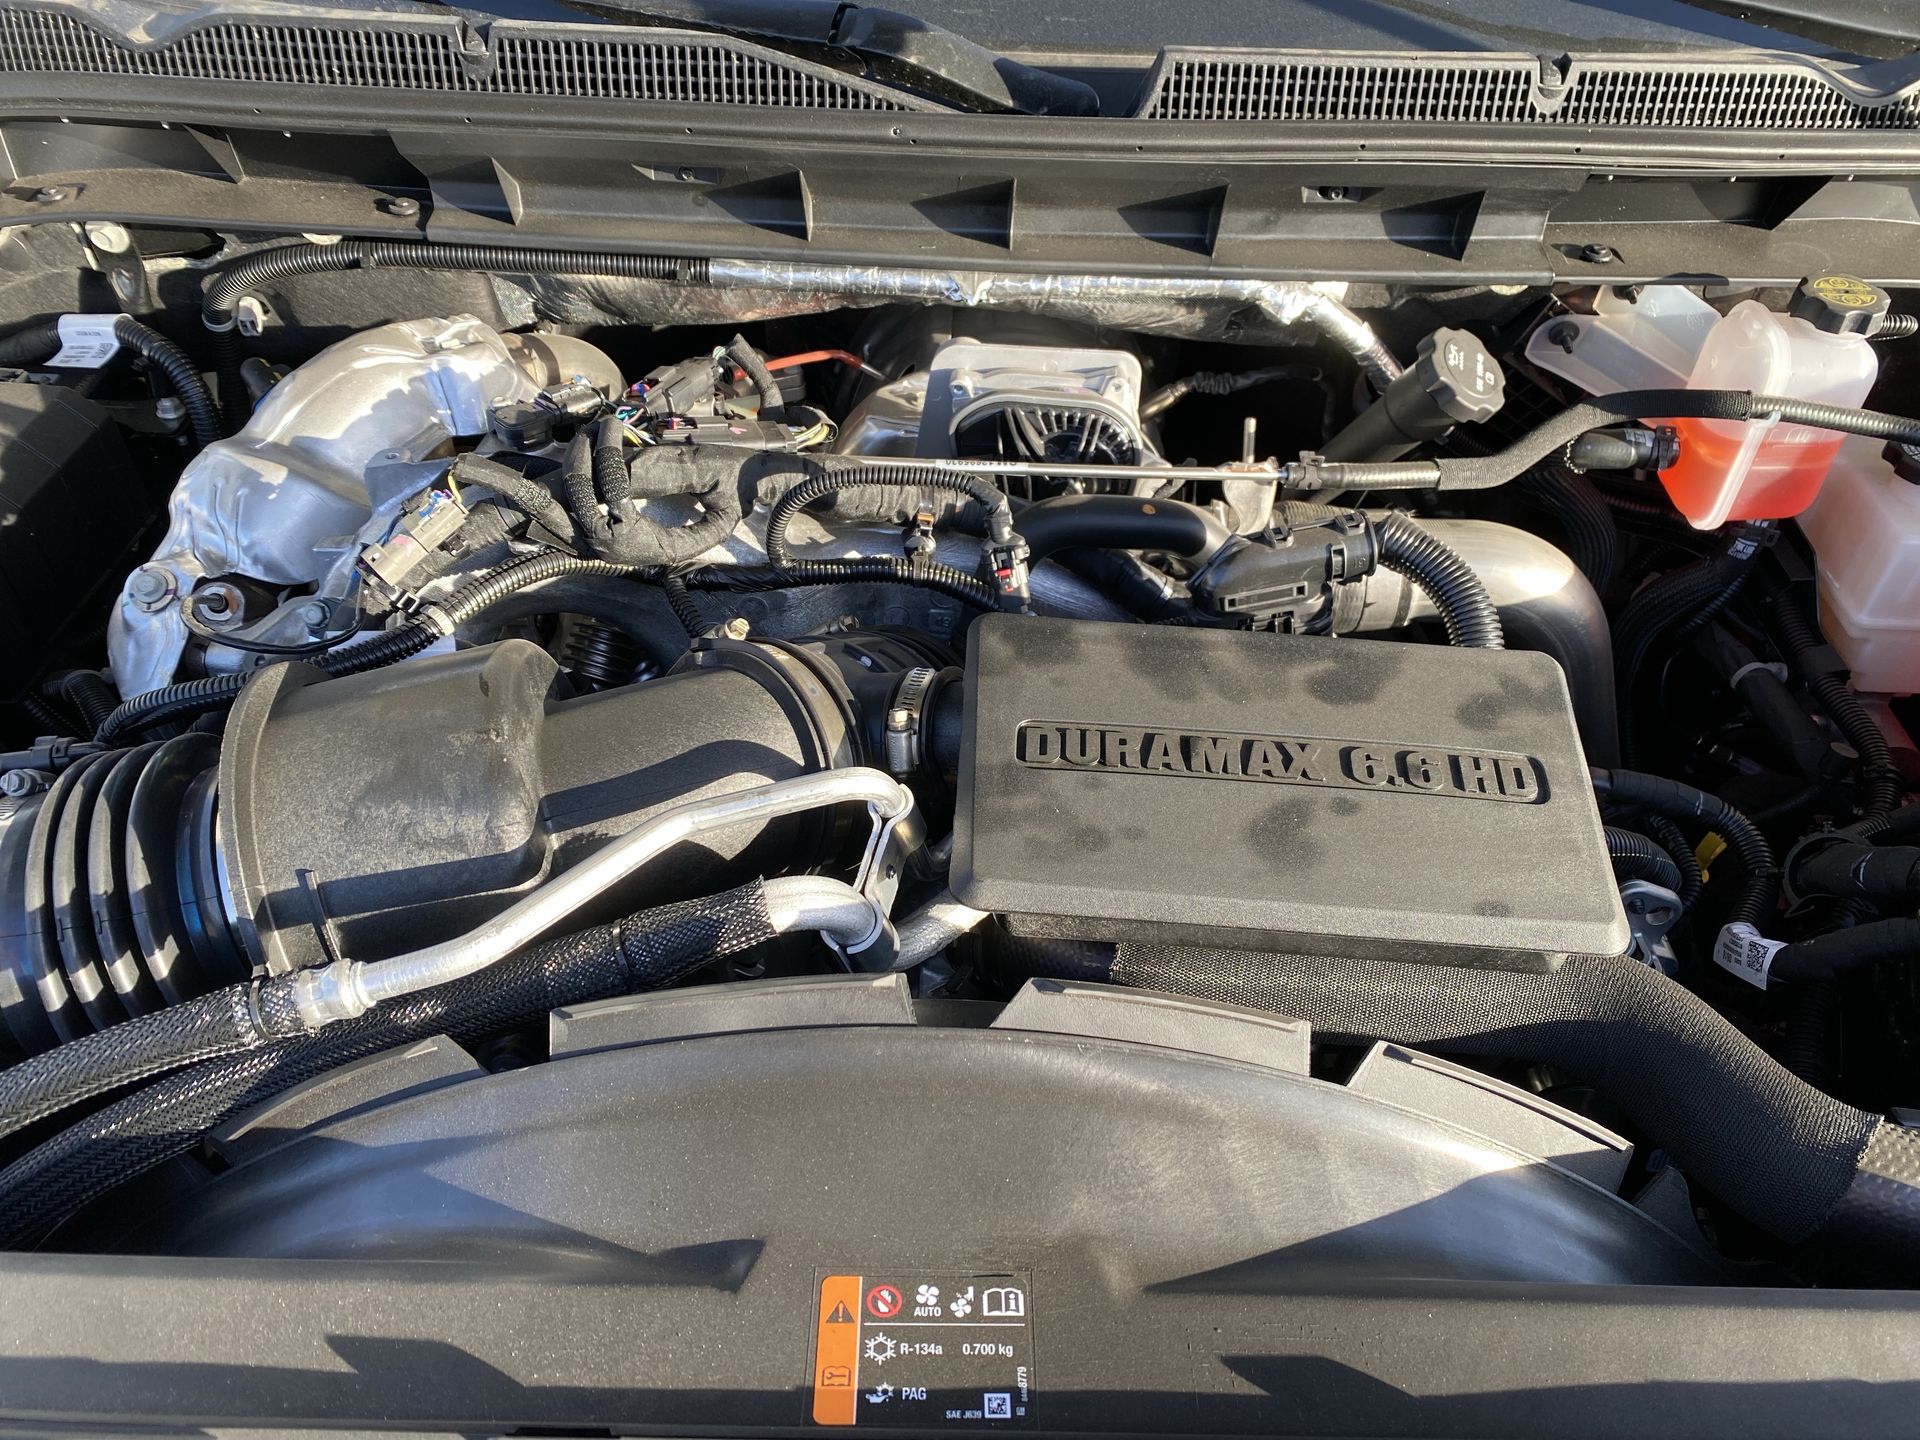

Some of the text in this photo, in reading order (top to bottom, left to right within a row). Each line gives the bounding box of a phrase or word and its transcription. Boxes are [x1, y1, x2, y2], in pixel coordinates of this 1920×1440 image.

[1024, 726, 1540, 798] DURAMAX 6.6 HD
[914, 1306, 941, 1317] AUTO
[900, 1342, 1013, 1357] R-134a 0.700 kg
[902, 1387, 927, 1400] PAG
[945, 1409, 962, 1419] SAE
